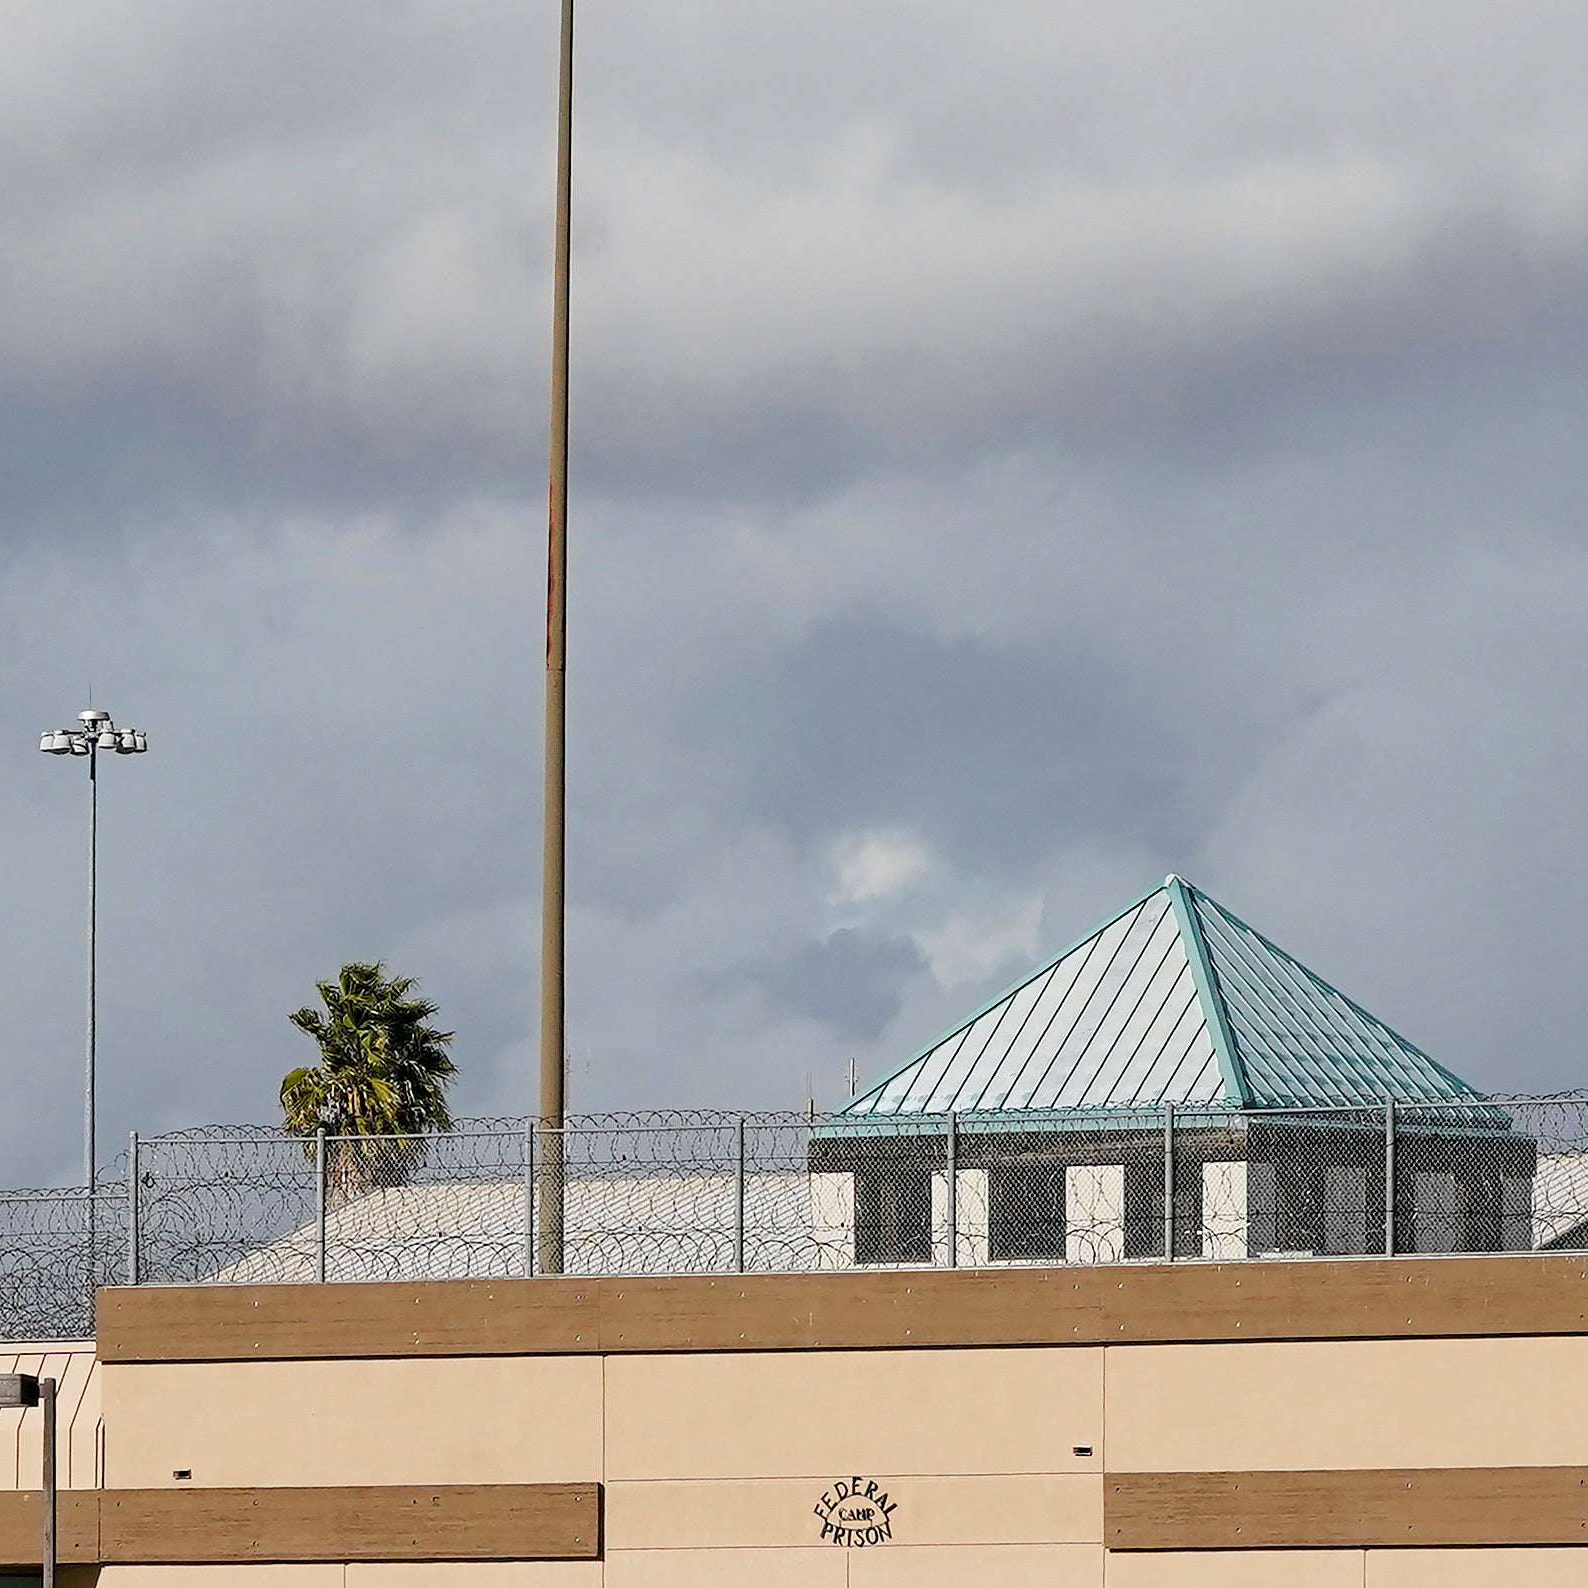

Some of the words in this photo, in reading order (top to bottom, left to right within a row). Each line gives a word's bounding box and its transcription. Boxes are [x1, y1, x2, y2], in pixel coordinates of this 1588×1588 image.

[813, 1476, 898, 1522] FEDERAL
[839, 1508, 876, 1521] CAMP
[820, 1521, 892, 1548] PRISON
